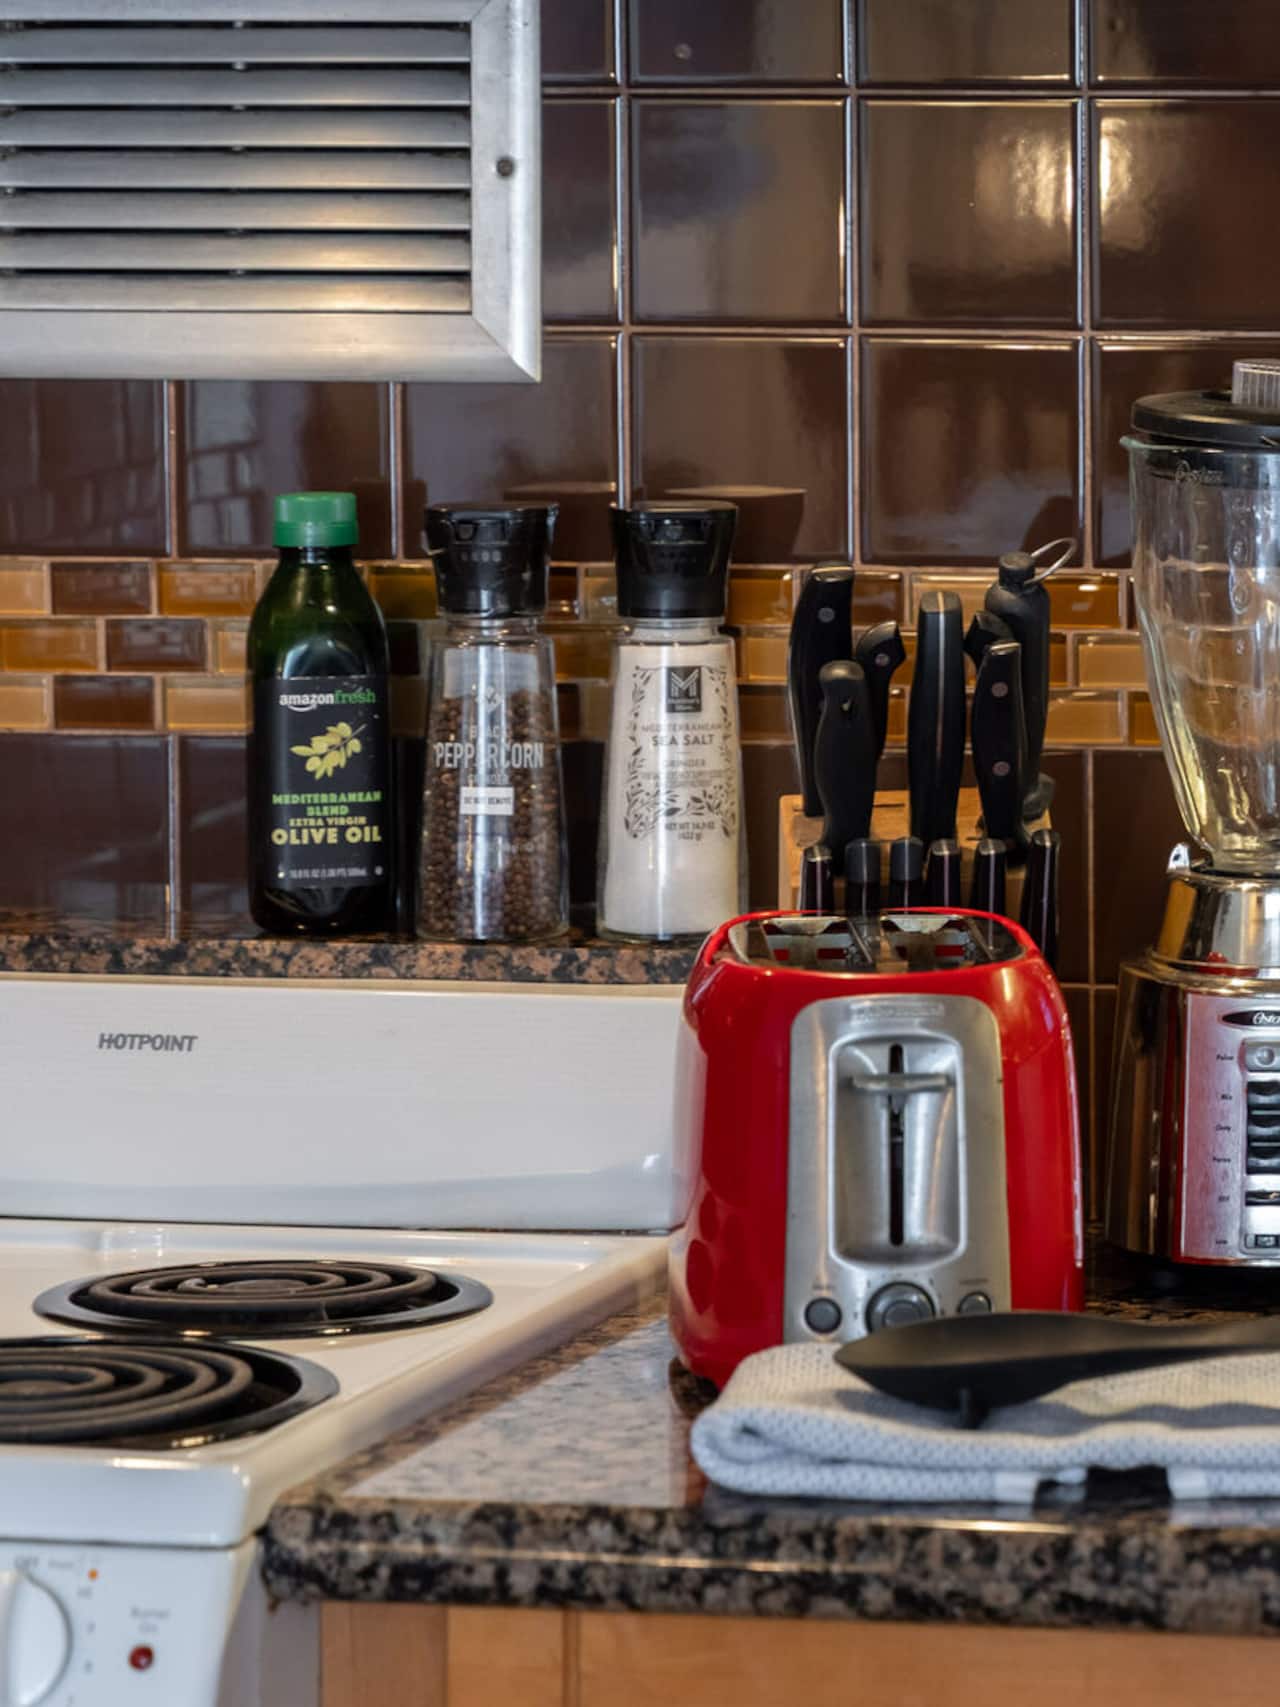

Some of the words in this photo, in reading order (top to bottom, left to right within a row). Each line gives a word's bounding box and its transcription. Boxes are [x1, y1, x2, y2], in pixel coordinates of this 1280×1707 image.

[683, 735, 715, 746] SALT
[434, 742, 544, 768] PEPPRCORN
[272, 791, 381, 804] MEDITERRANEAN
[306, 806, 348, 816] BLEND
[289, 818, 325, 827] EXTRA
[326, 816, 367, 826] VIRGIN
[271, 827, 339, 845] OLIVE
[345, 826, 382, 843] OIL
[98, 1033, 198, 1052] HOTPOINT
